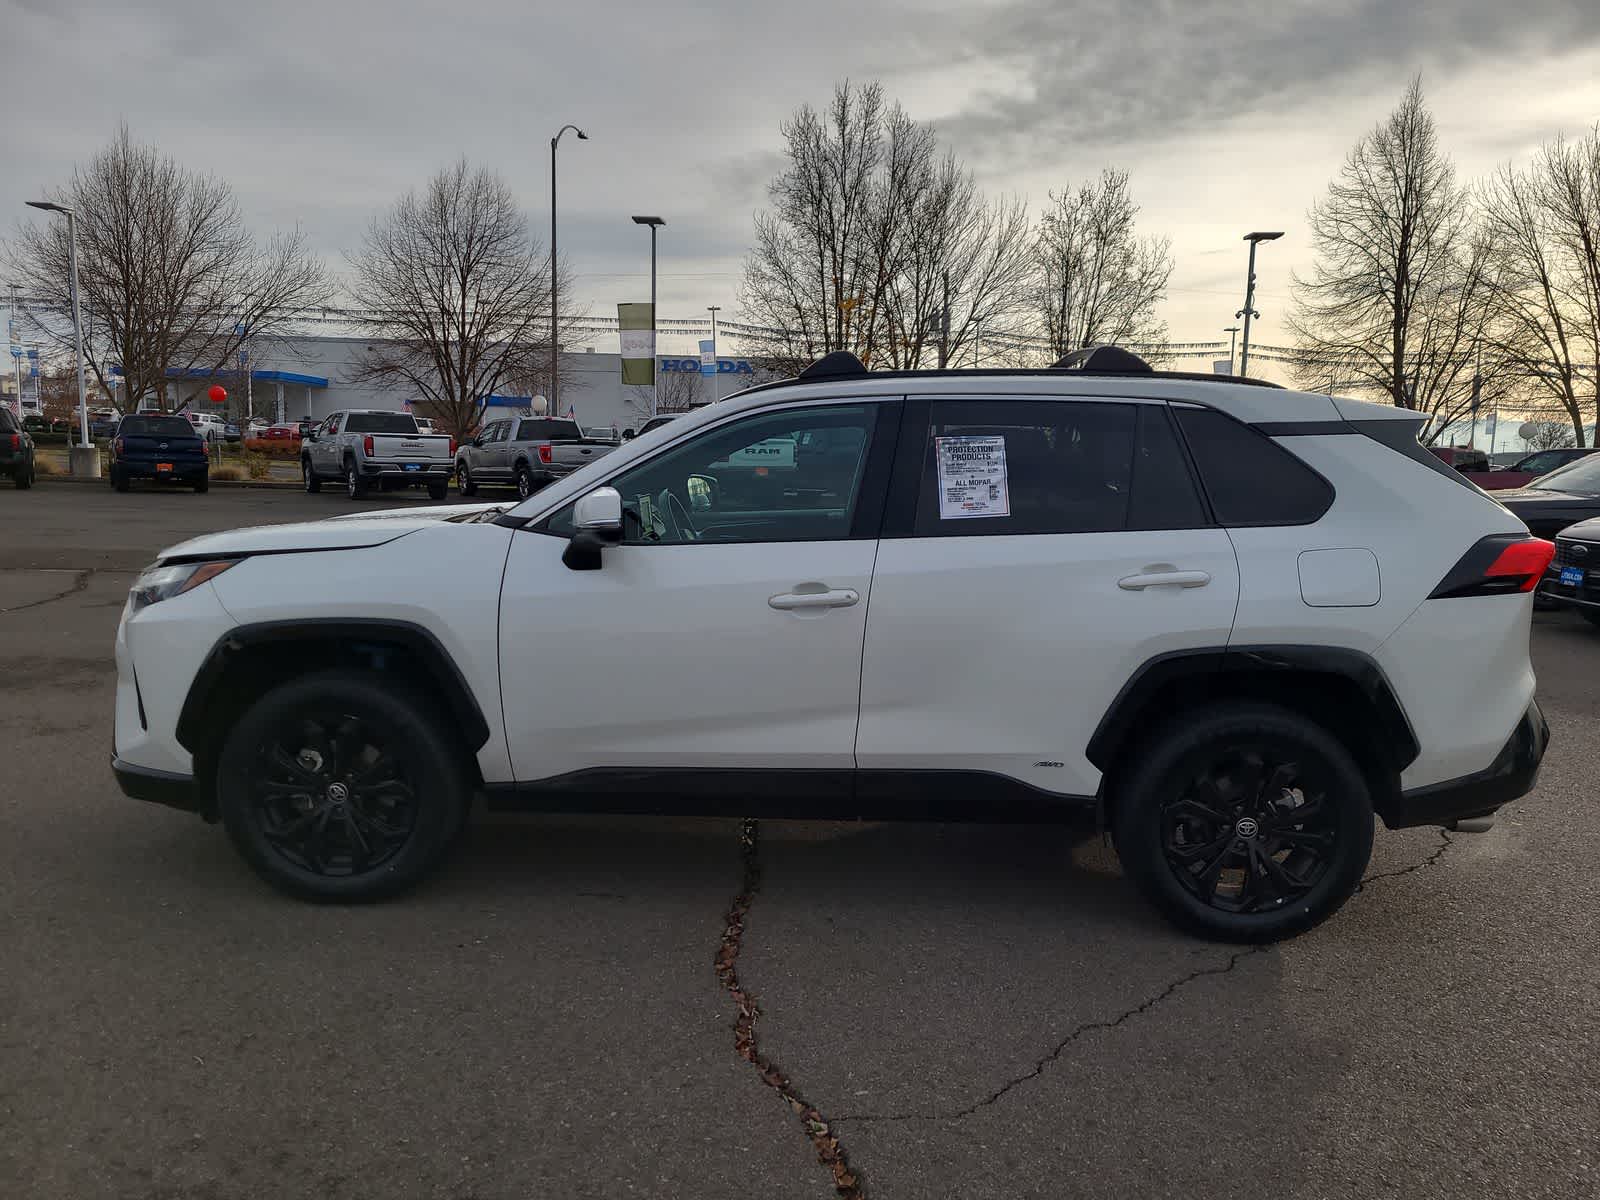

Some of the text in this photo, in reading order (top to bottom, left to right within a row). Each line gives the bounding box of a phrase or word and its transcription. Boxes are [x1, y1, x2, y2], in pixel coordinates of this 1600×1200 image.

[661, 360, 752, 373] HODA
[948, 445, 993, 453] PROTECTION
[952, 453, 991, 461] PRODUCTS
[955, 479, 967, 487] ALL
